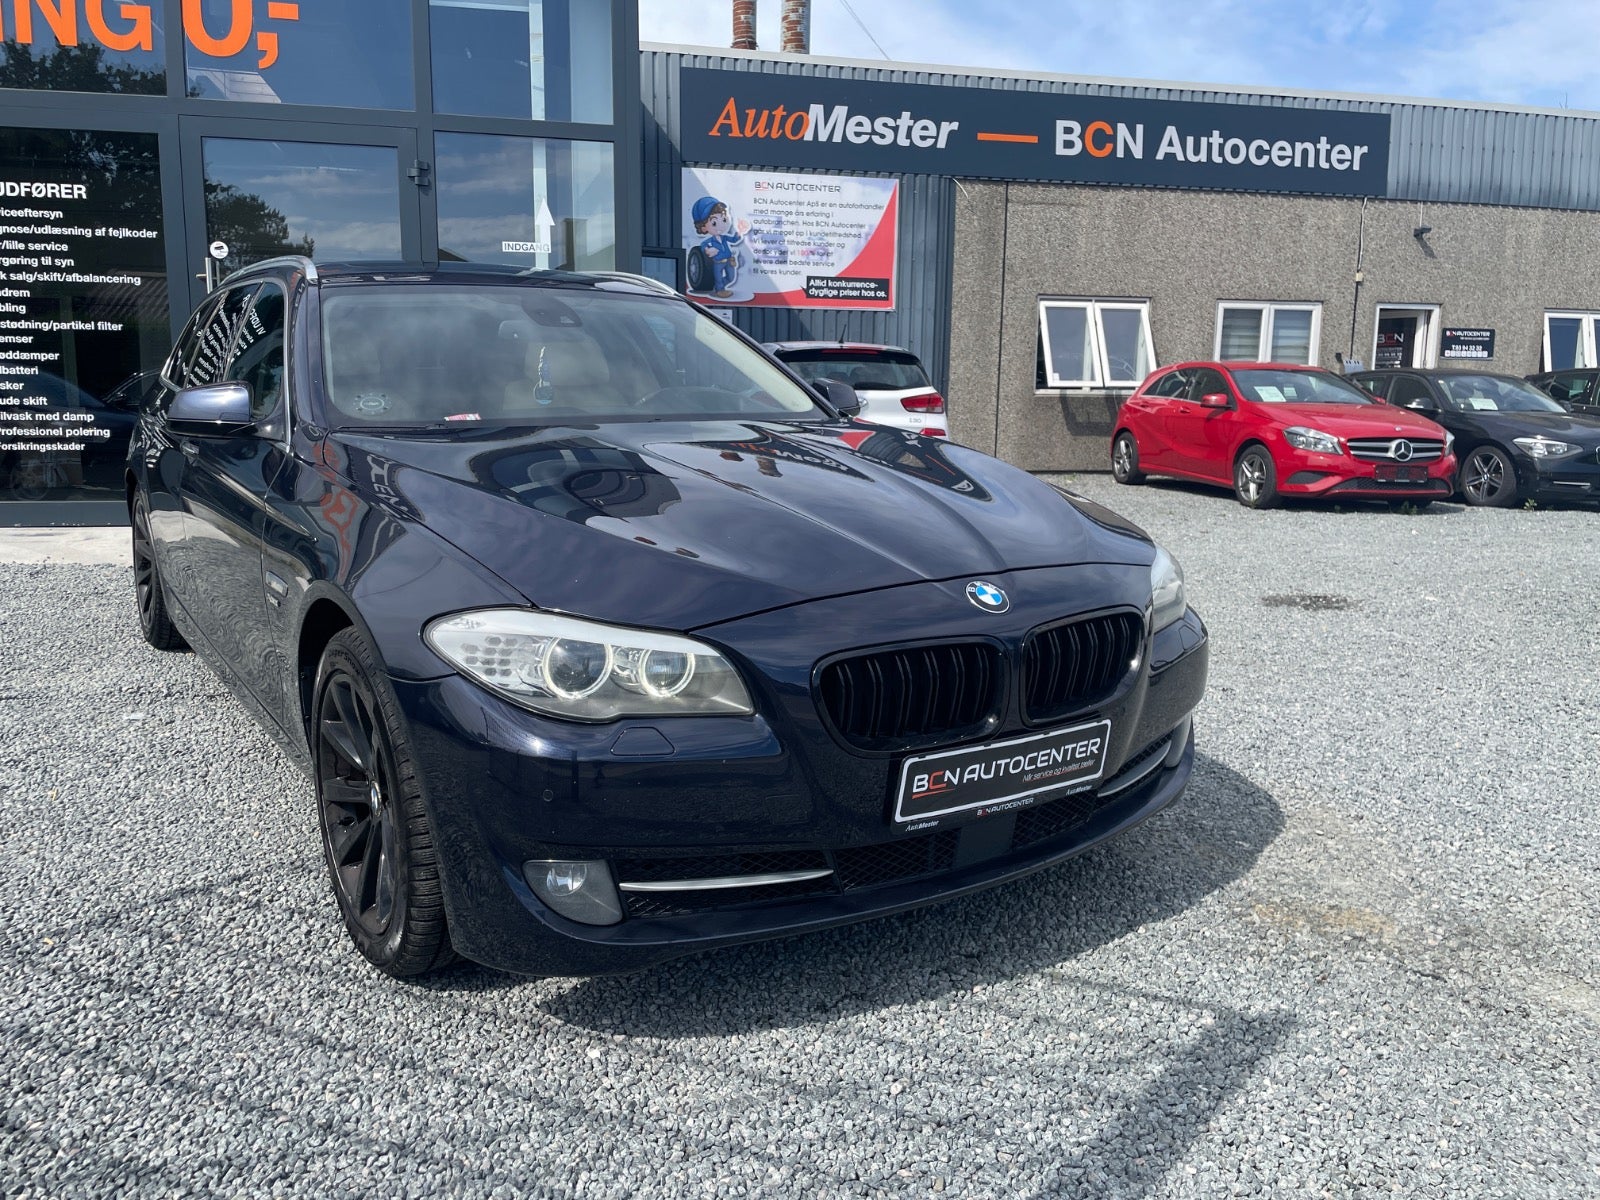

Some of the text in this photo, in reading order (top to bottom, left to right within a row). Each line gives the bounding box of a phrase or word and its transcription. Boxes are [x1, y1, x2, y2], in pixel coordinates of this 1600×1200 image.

[709, 97, 1368, 171] AutoMester BCN Autocenter
[754, 181, 841, 192] BCN AUTOCENTER
[753, 197, 768, 205] BCN
[769, 198, 805, 207] Autocenter
[806, 200, 819, 208] ApS
[770, 209, 793, 217] mange
[805, 209, 830, 218] erfaring
[94, 227, 106, 237] af
[108, 227, 158, 239] fejlkoder
[28, 241, 69, 252] service
[504, 243, 550, 252] INDGANG
[40, 256, 52, 266] til
[54, 258, 75, 268] syn
[9, 272, 141, 285] salg/skift/afbalancering
[828, 280, 878, 289] konkurrence-
[839, 288, 860, 297] priser
[861, 289, 875, 297] hos
[97, 320, 123, 331] filter
[23, 396, 48, 406] skift
[35, 412, 60, 421] med
[62, 412, 95, 423] damp
[65, 427, 111, 438] polering
[912, 737, 1101, 793] BCN AUTOCENTER
[1033, 769, 1054, 780] service
[991, 797, 1034, 812] AUTOCENTER
